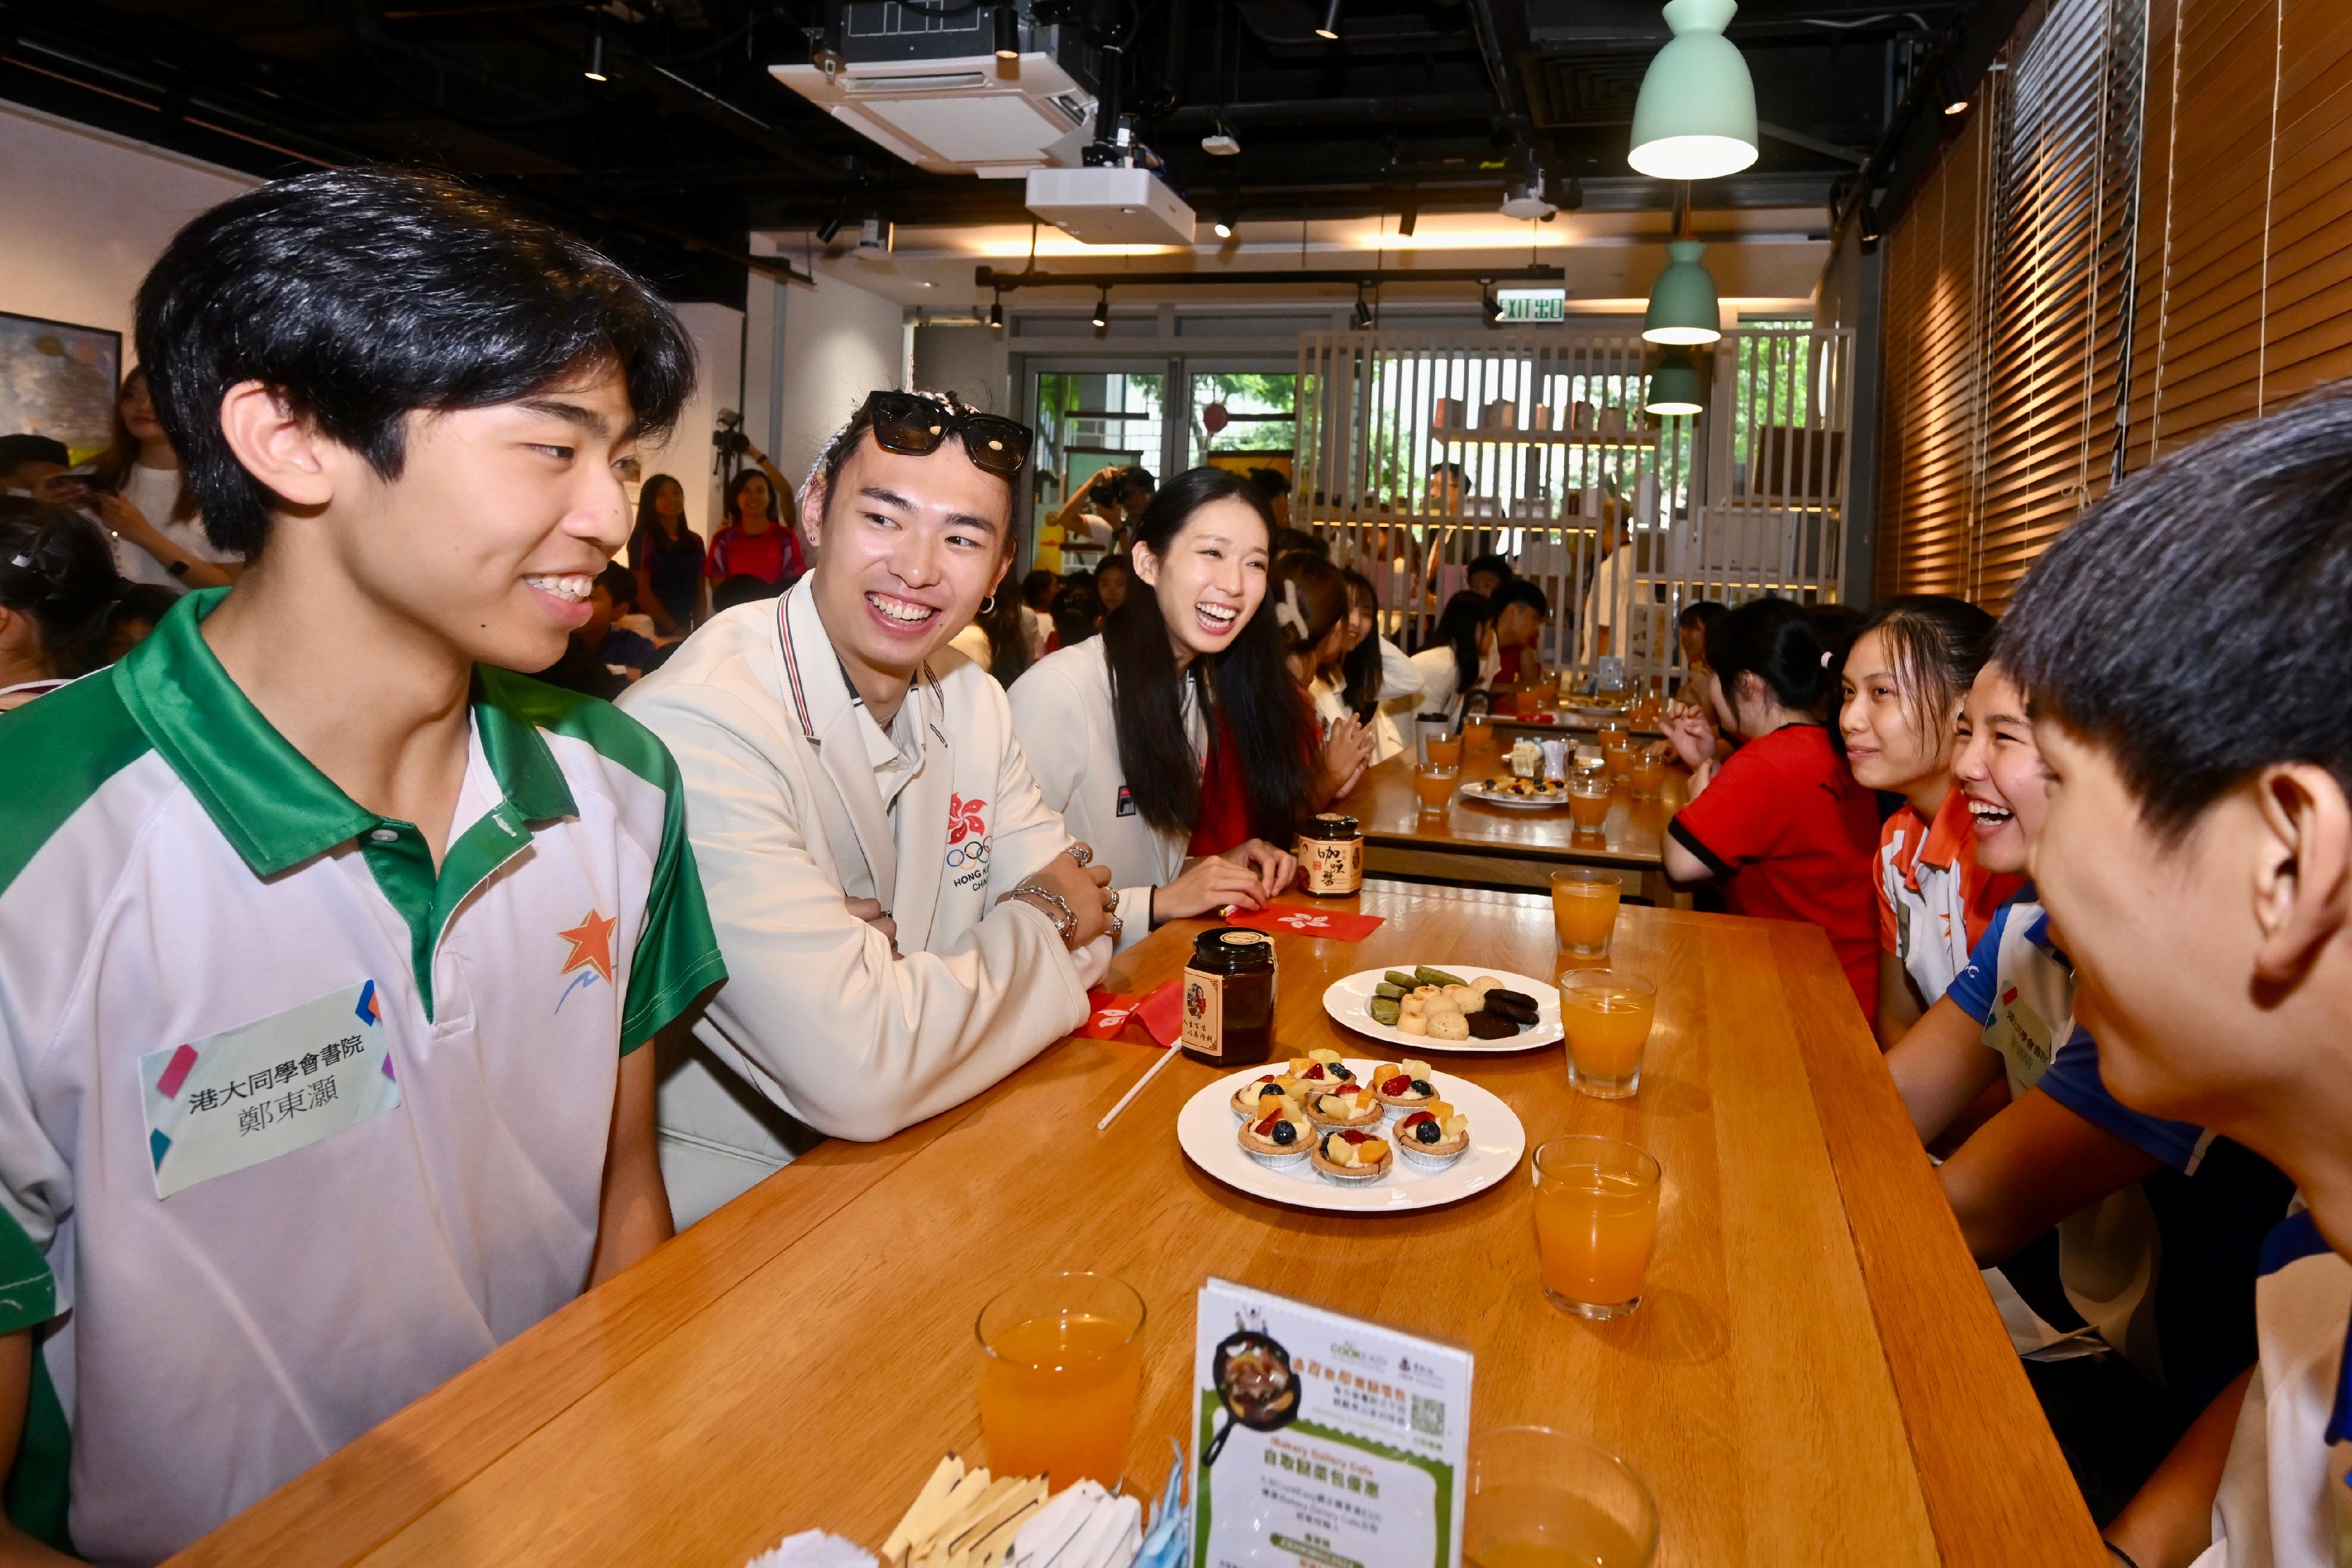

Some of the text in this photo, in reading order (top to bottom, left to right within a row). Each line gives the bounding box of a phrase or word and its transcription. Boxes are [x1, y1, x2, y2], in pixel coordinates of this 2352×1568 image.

[1499, 299, 1562, 318] EXIT 出口
[954, 870, 981, 887] HONG
[973, 878, 987, 891] CHIN
[189, 1035, 364, 1114] 港大同學會書院
[238, 1076, 339, 1137] 鄭東灝
